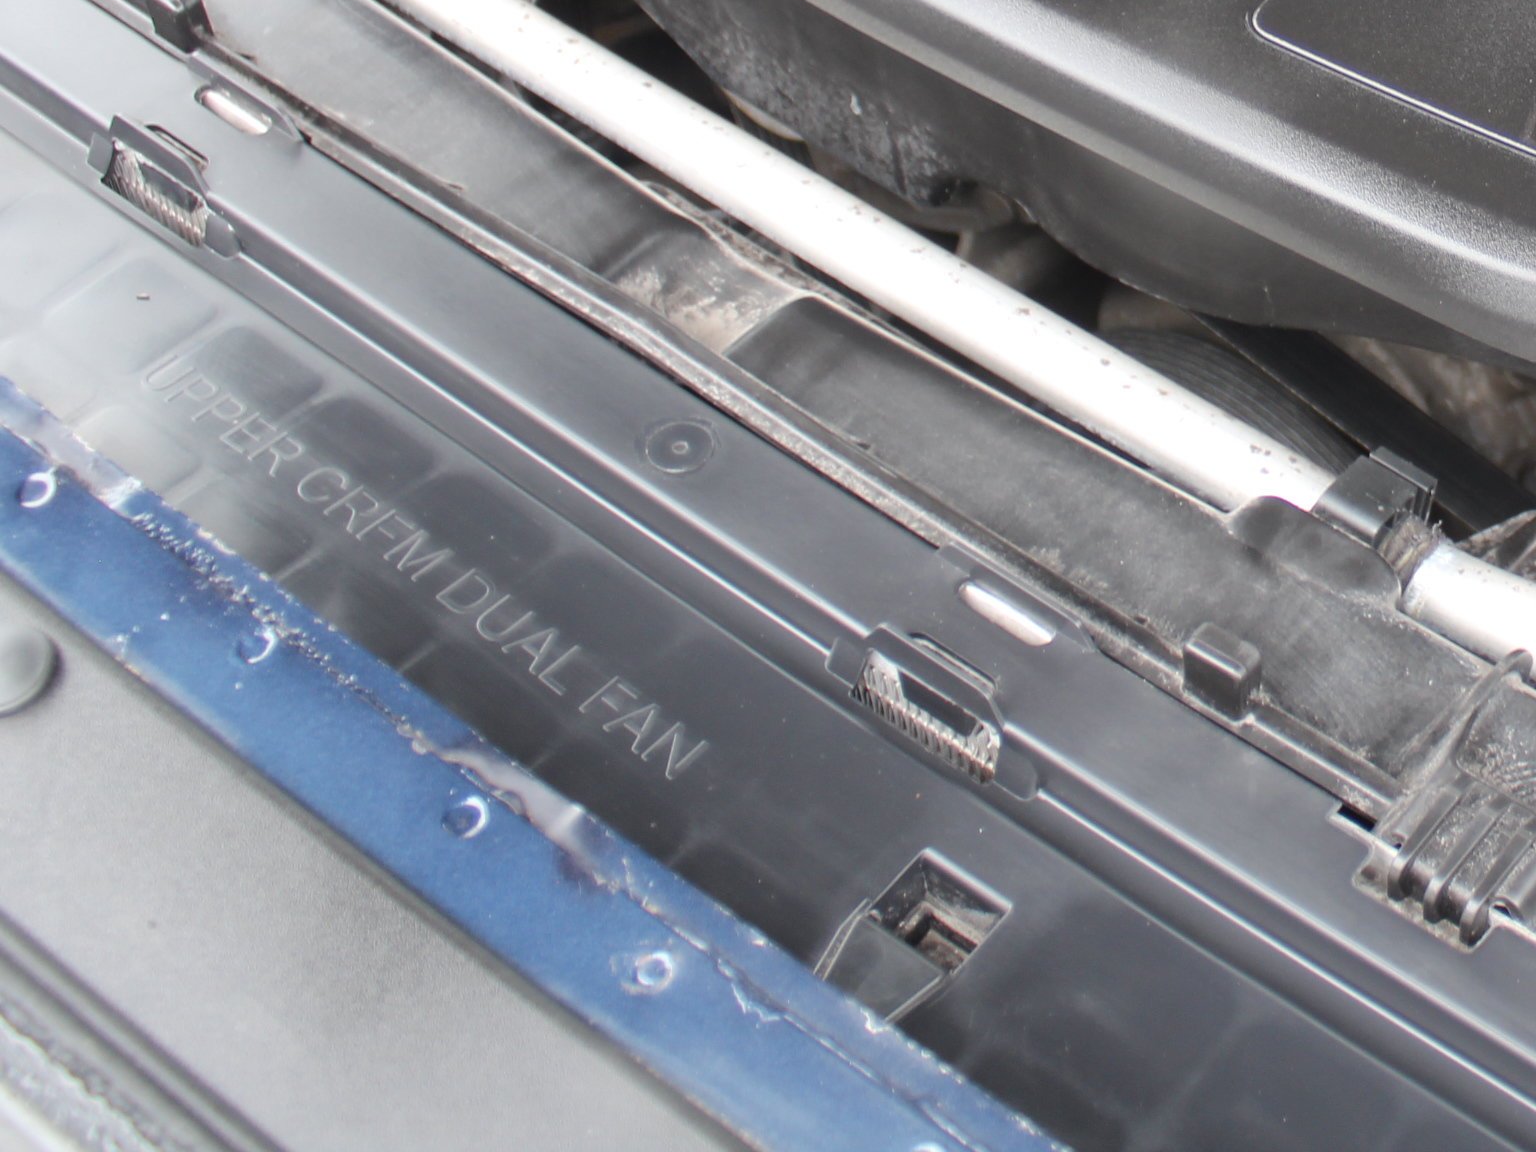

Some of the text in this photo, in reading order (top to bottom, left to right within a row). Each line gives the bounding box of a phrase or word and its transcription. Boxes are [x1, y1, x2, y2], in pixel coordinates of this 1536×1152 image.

[141, 355, 709, 780] UPPER CRFM DUAL FAN
